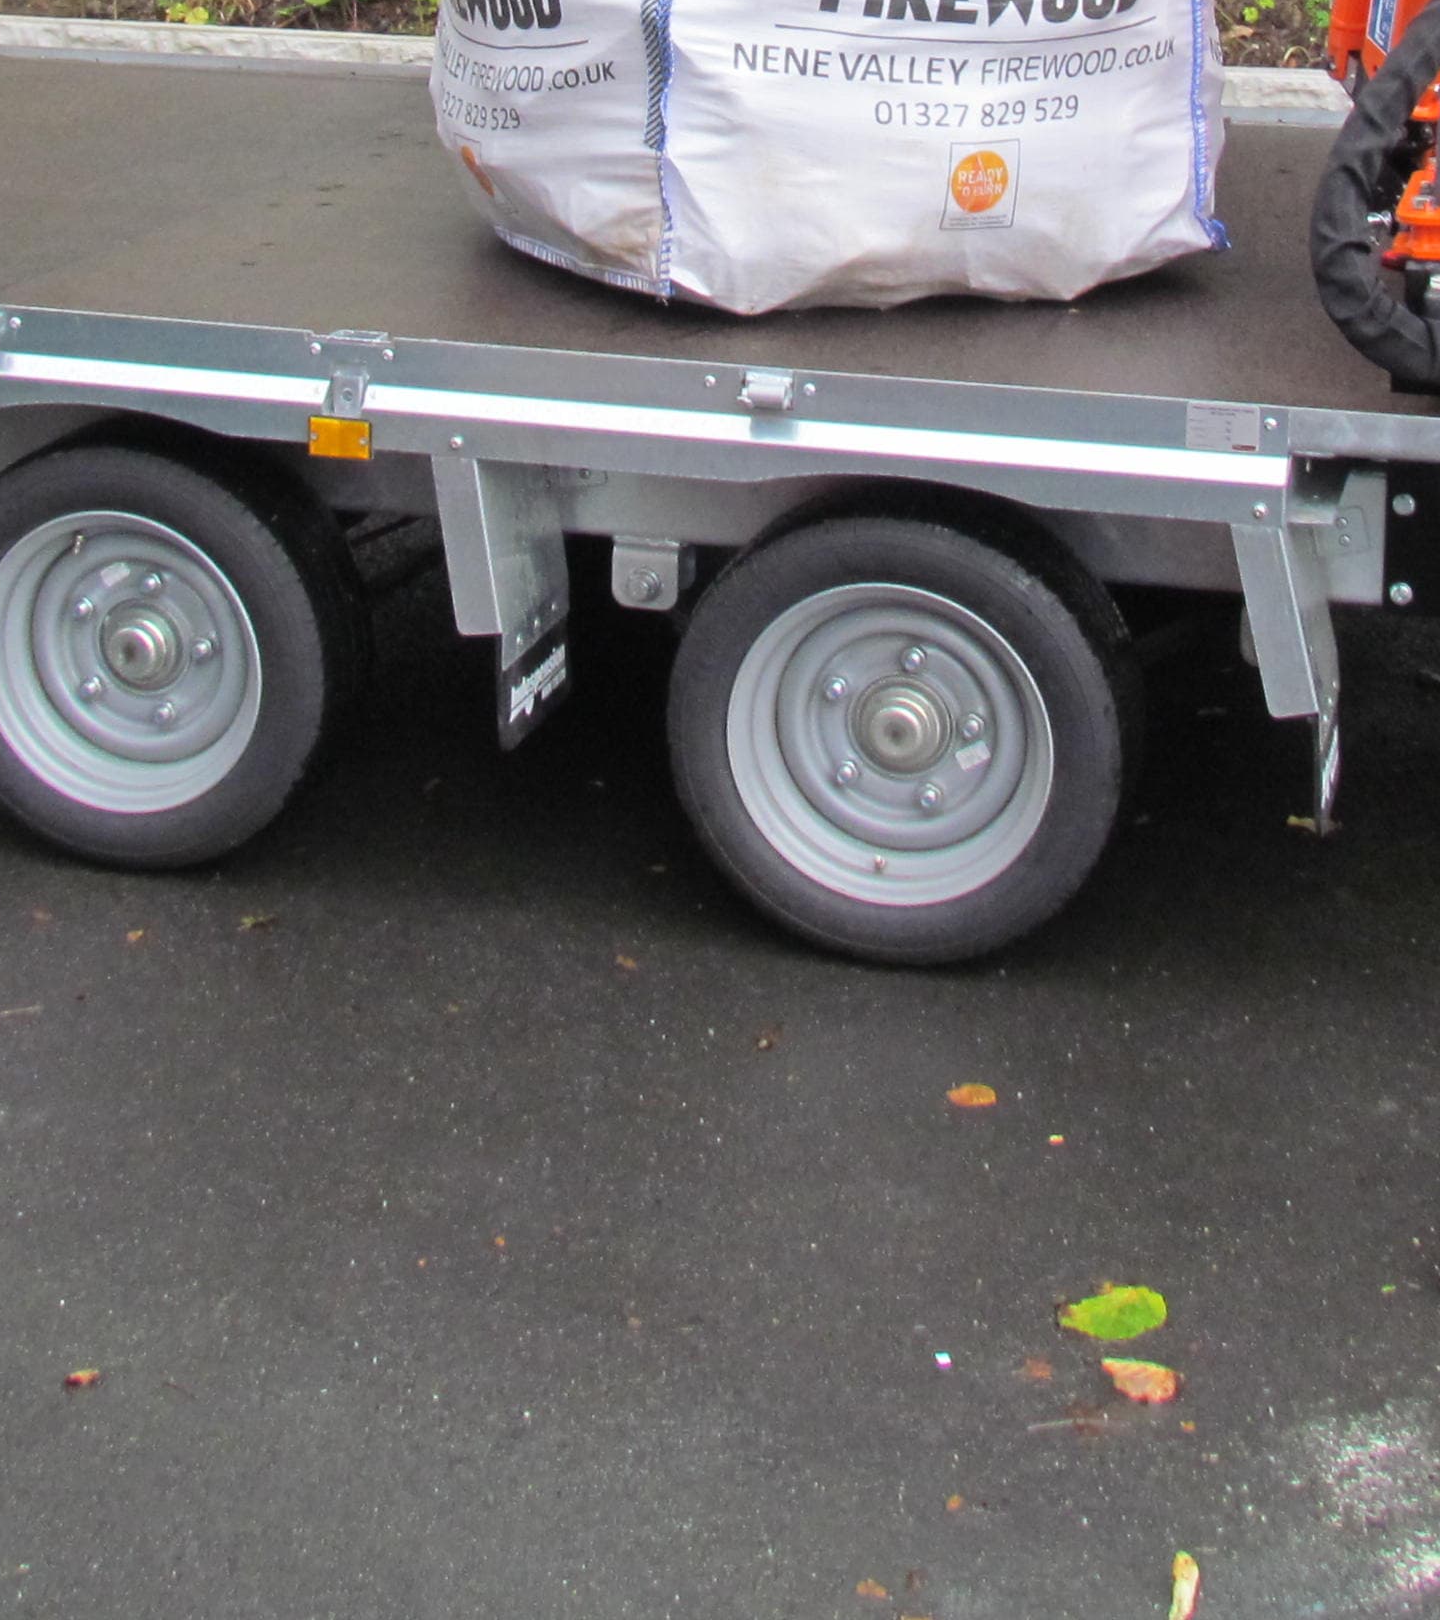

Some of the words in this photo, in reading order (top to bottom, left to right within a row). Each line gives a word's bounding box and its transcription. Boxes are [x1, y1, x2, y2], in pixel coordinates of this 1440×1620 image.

[733, 43, 832, 78] NENE
[839, 52, 969, 86] VALLEY
[464, 105, 488, 129] 829
[491, 108, 520, 130] 529
[875, 100, 969, 127] 01327
[980, 100, 1025, 127] 829
[1034, 94, 1079, 121] 529
